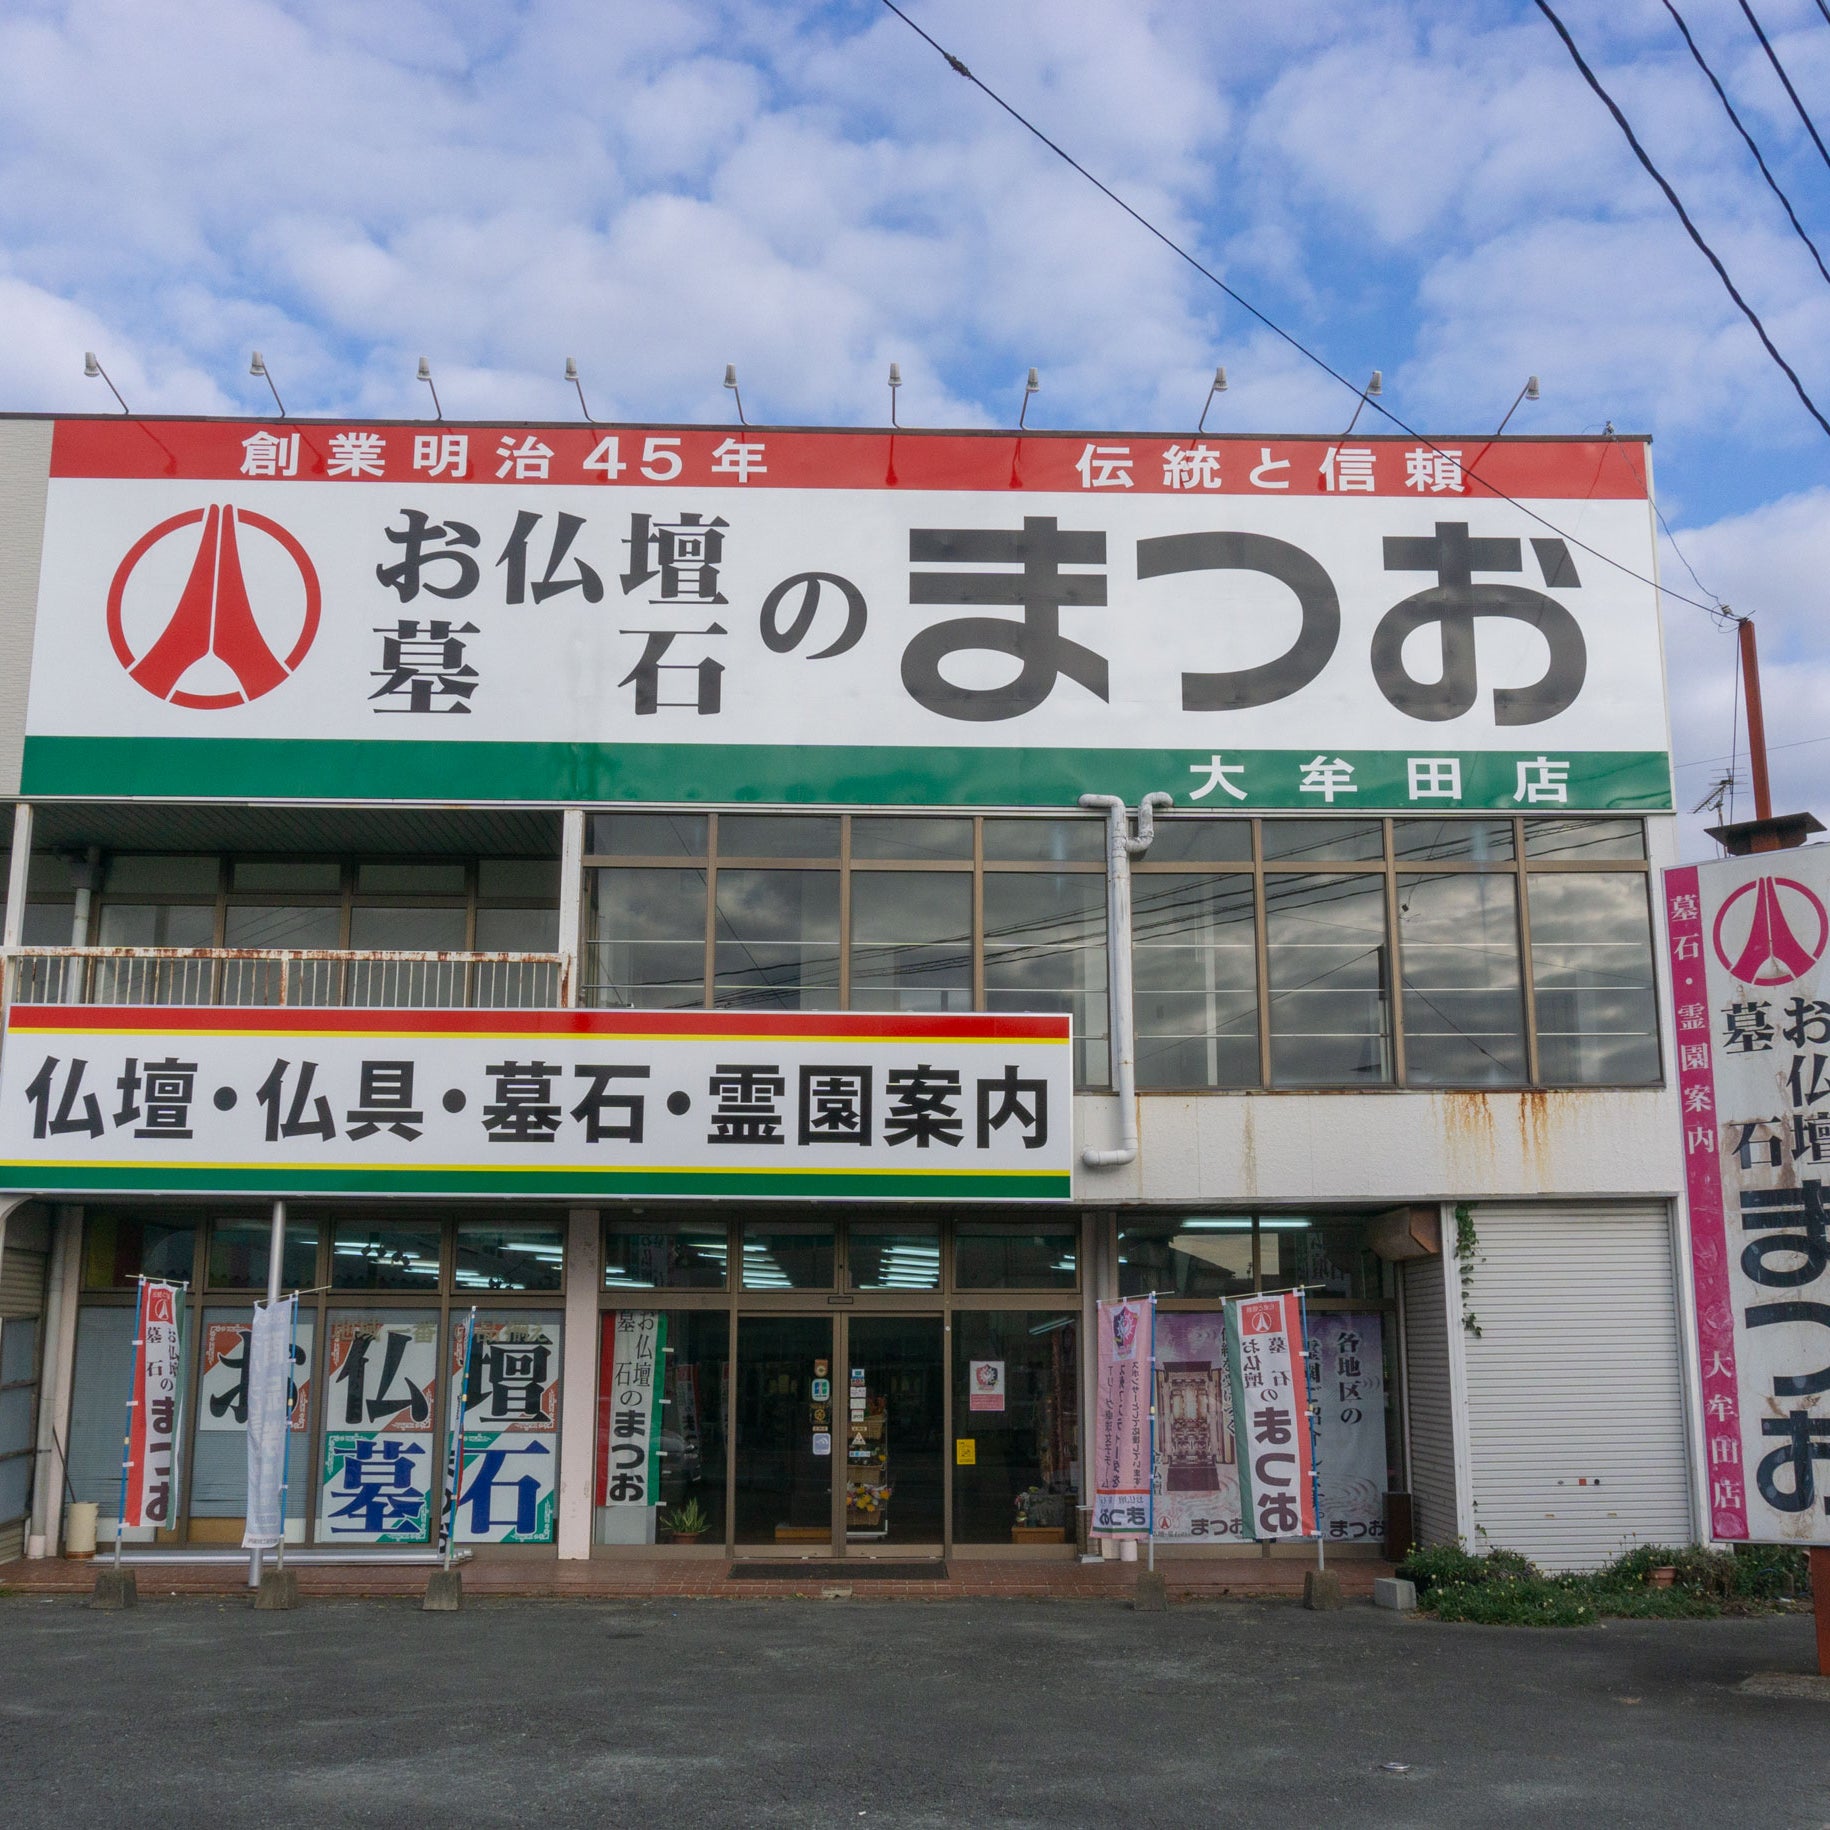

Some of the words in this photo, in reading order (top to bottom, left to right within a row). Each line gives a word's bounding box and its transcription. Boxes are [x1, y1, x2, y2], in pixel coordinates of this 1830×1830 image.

[240, 430, 768, 483] 創業明治45年
[1076, 443, 1465, 494] 伝統と信頼
[376, 508, 729, 607] お仏壇
[368, 620, 727, 716] 墓石
[760, 571, 867, 659] の
[901, 516, 1587, 726] まつお
[1190, 755, 1570, 803] 大牟田店
[1671, 894, 1714, 1155] 墓石・霊園案内
[24, 1055, 1049, 1149] 仏壇・仏具・墓石・霊園案内
[1721, 1001, 1783, 1170] 墓石
[632, 1311, 656, 1387] お仏壇
[1337, 1332, 1363, 1425] 各地区の
[609, 1409, 646, 1502] まつお
[1702, 1350, 1741, 1509] 大牟田店
[329, 1440, 551, 1535] 墓石
